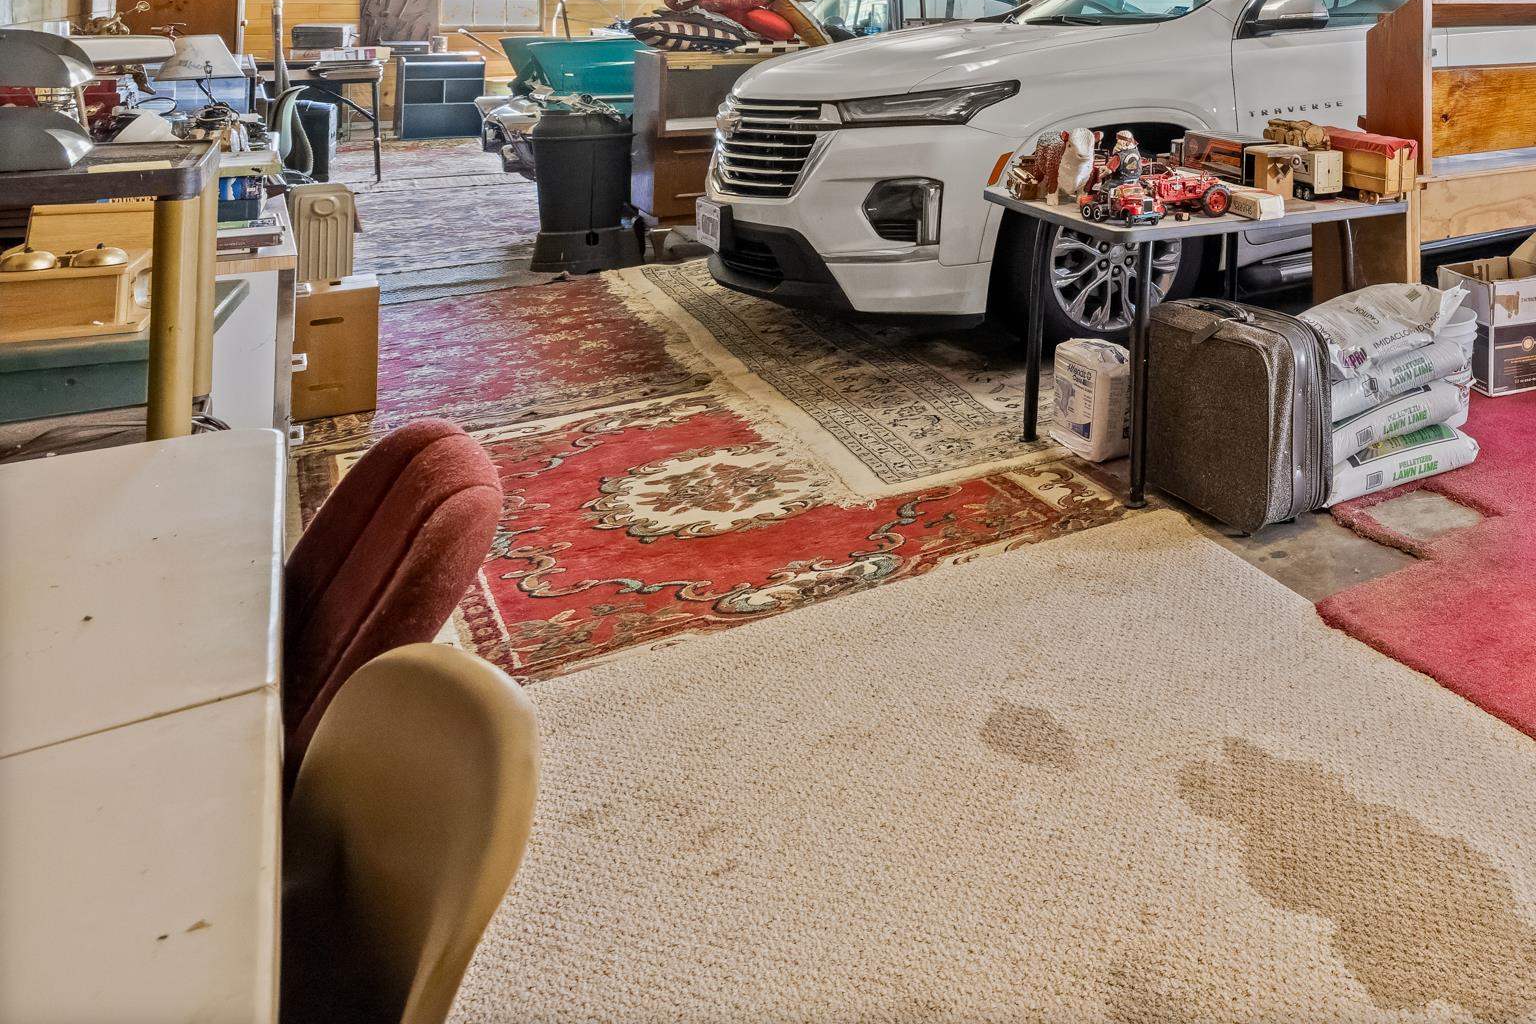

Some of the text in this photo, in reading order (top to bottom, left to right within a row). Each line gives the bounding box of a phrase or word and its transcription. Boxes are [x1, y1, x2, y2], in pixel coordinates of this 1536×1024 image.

[1248, 100, 1343, 118] TRAVERSE
[1353, 305, 1380, 325] CAUTION
[1373, 324, 1425, 349] IMIDACLOID
[1389, 361, 1435, 388] LAWN LIME
[1383, 410, 1428, 435] LAWN LIME
[1392, 460, 1439, 482] LAWN LIME
[1399, 454, 1433, 470] PELLETIZED
